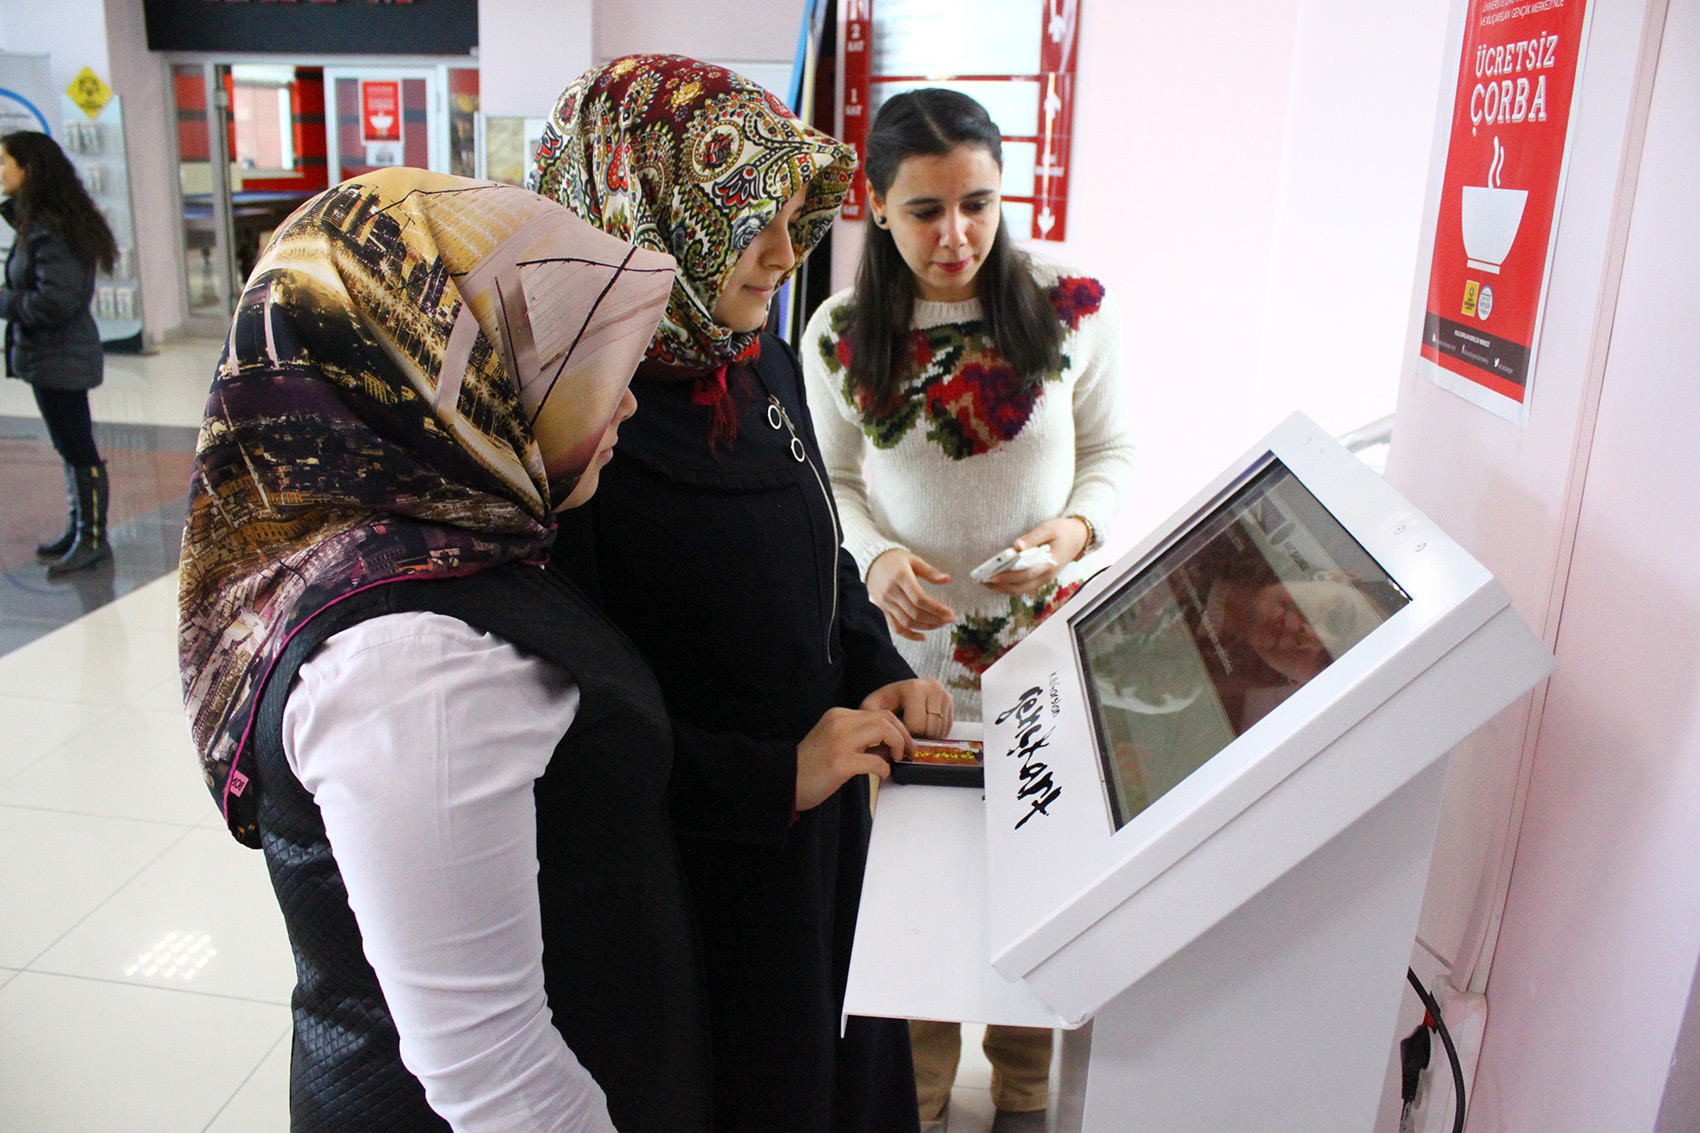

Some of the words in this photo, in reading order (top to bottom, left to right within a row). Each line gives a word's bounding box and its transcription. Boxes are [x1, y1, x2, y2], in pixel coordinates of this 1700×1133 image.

[851, 23, 860, 39] 2
[1475, 30, 1558, 78] ÜCRETSİZ
[1470, 74, 1547, 137] ÇORBA
